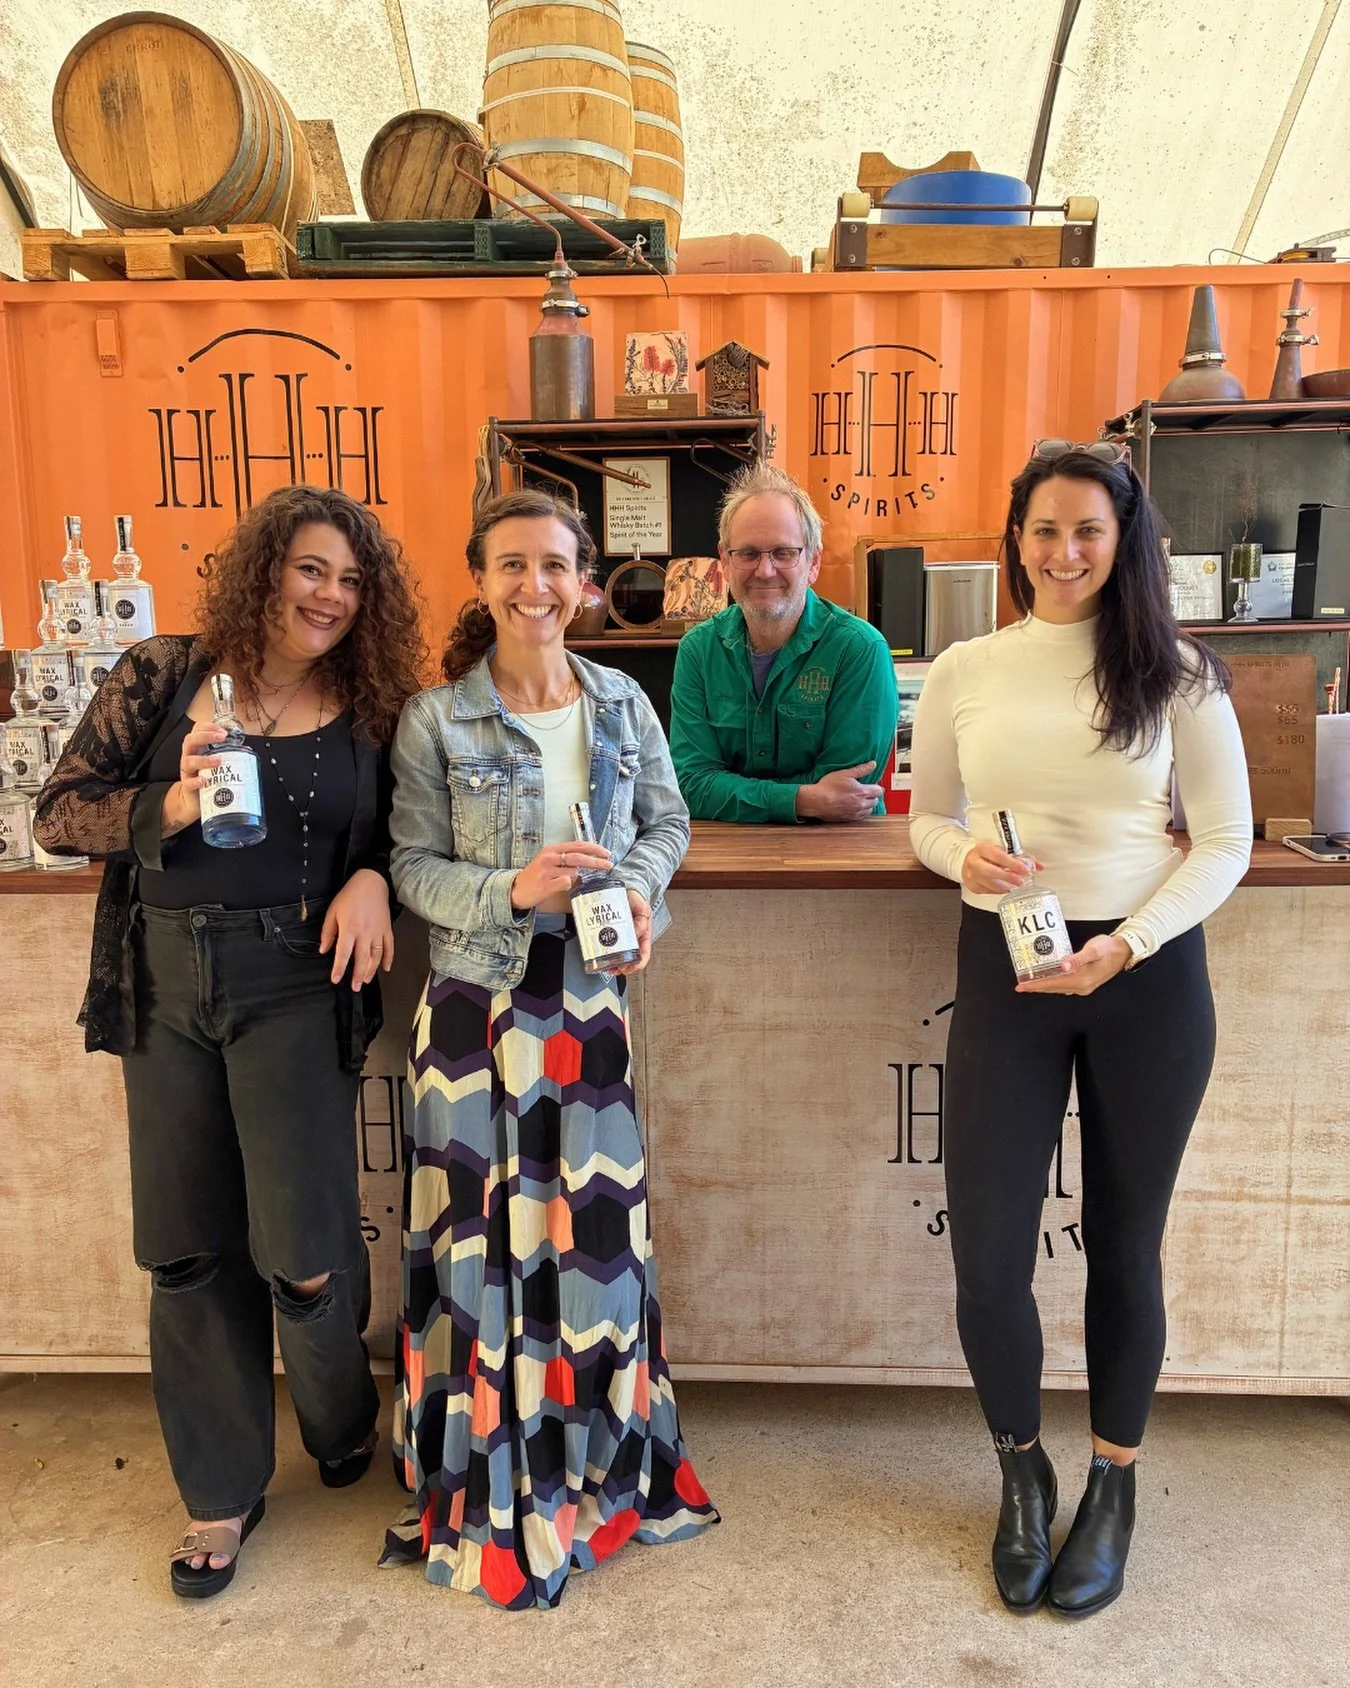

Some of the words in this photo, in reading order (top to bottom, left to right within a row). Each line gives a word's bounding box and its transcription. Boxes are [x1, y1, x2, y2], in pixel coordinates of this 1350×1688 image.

[810, 371, 959, 477] HHH
[831, 483, 936, 517] SPIRITS
[609, 504, 625, 512] HHH
[625, 504, 647, 512] Spirits
[609, 514, 630, 523] Single
[609, 521, 634, 529] Whisky
[609, 531, 628, 539] Spirit
[64, 601, 80, 609] WAX
[40, 667, 56, 675] WAX
[1277, 734, 1305, 745] $180
[211, 765, 232, 777] WAX
[204, 773, 243, 788] LYRICAL
[591, 903, 613, 915] WAX
[586, 911, 622, 926] LYRICAL
[1017, 911, 1056, 935] KLC
